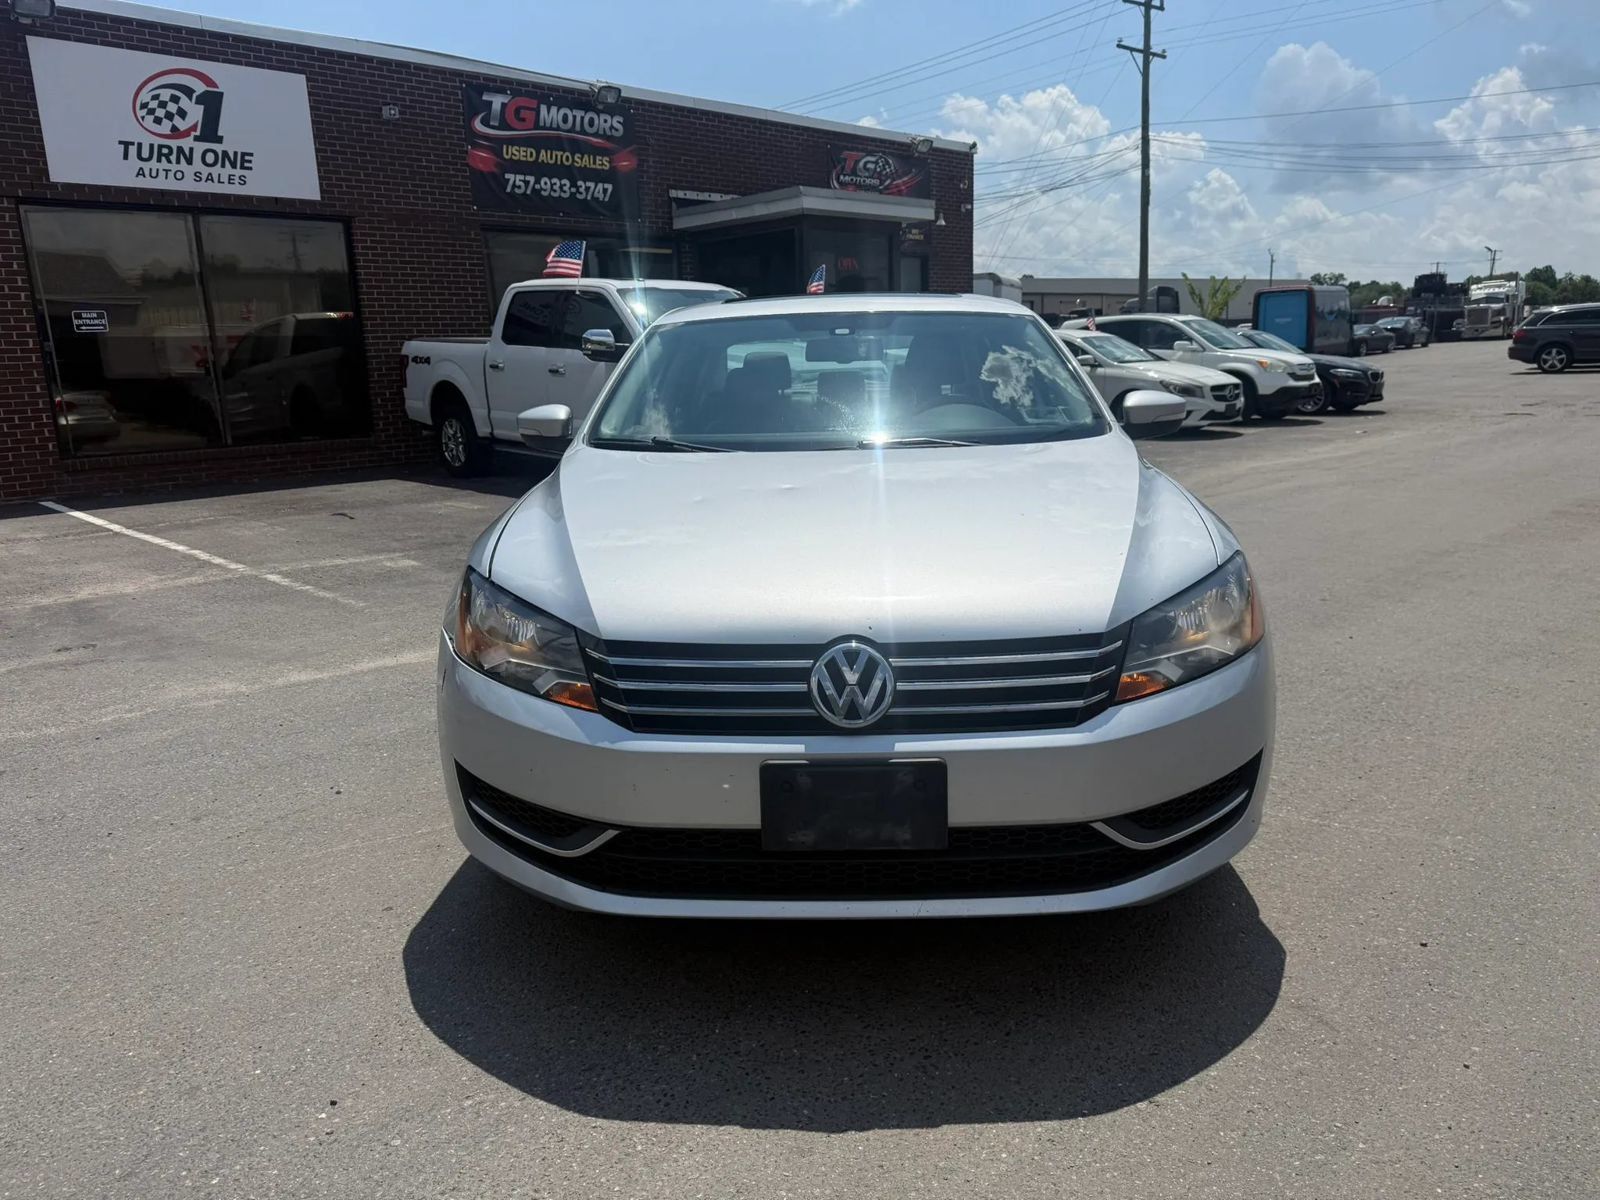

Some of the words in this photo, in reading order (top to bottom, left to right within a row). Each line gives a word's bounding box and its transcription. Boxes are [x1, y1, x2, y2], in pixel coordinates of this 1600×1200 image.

[193, 89, 225, 144] 1
[482, 91, 539, 130] TG
[539, 103, 625, 137] MOTORS
[118, 140, 194, 166] TURN
[200, 148, 255, 171] ONE
[502, 144, 536, 162] USED
[538, 150, 573, 166] AUTO
[574, 154, 611, 170] SALES
[135, 167, 185, 181] AUTO
[193, 171, 247, 186] SALES
[504, 172, 613, 202] 757-933-3747
[838, 174, 881, 187] MOTORS
